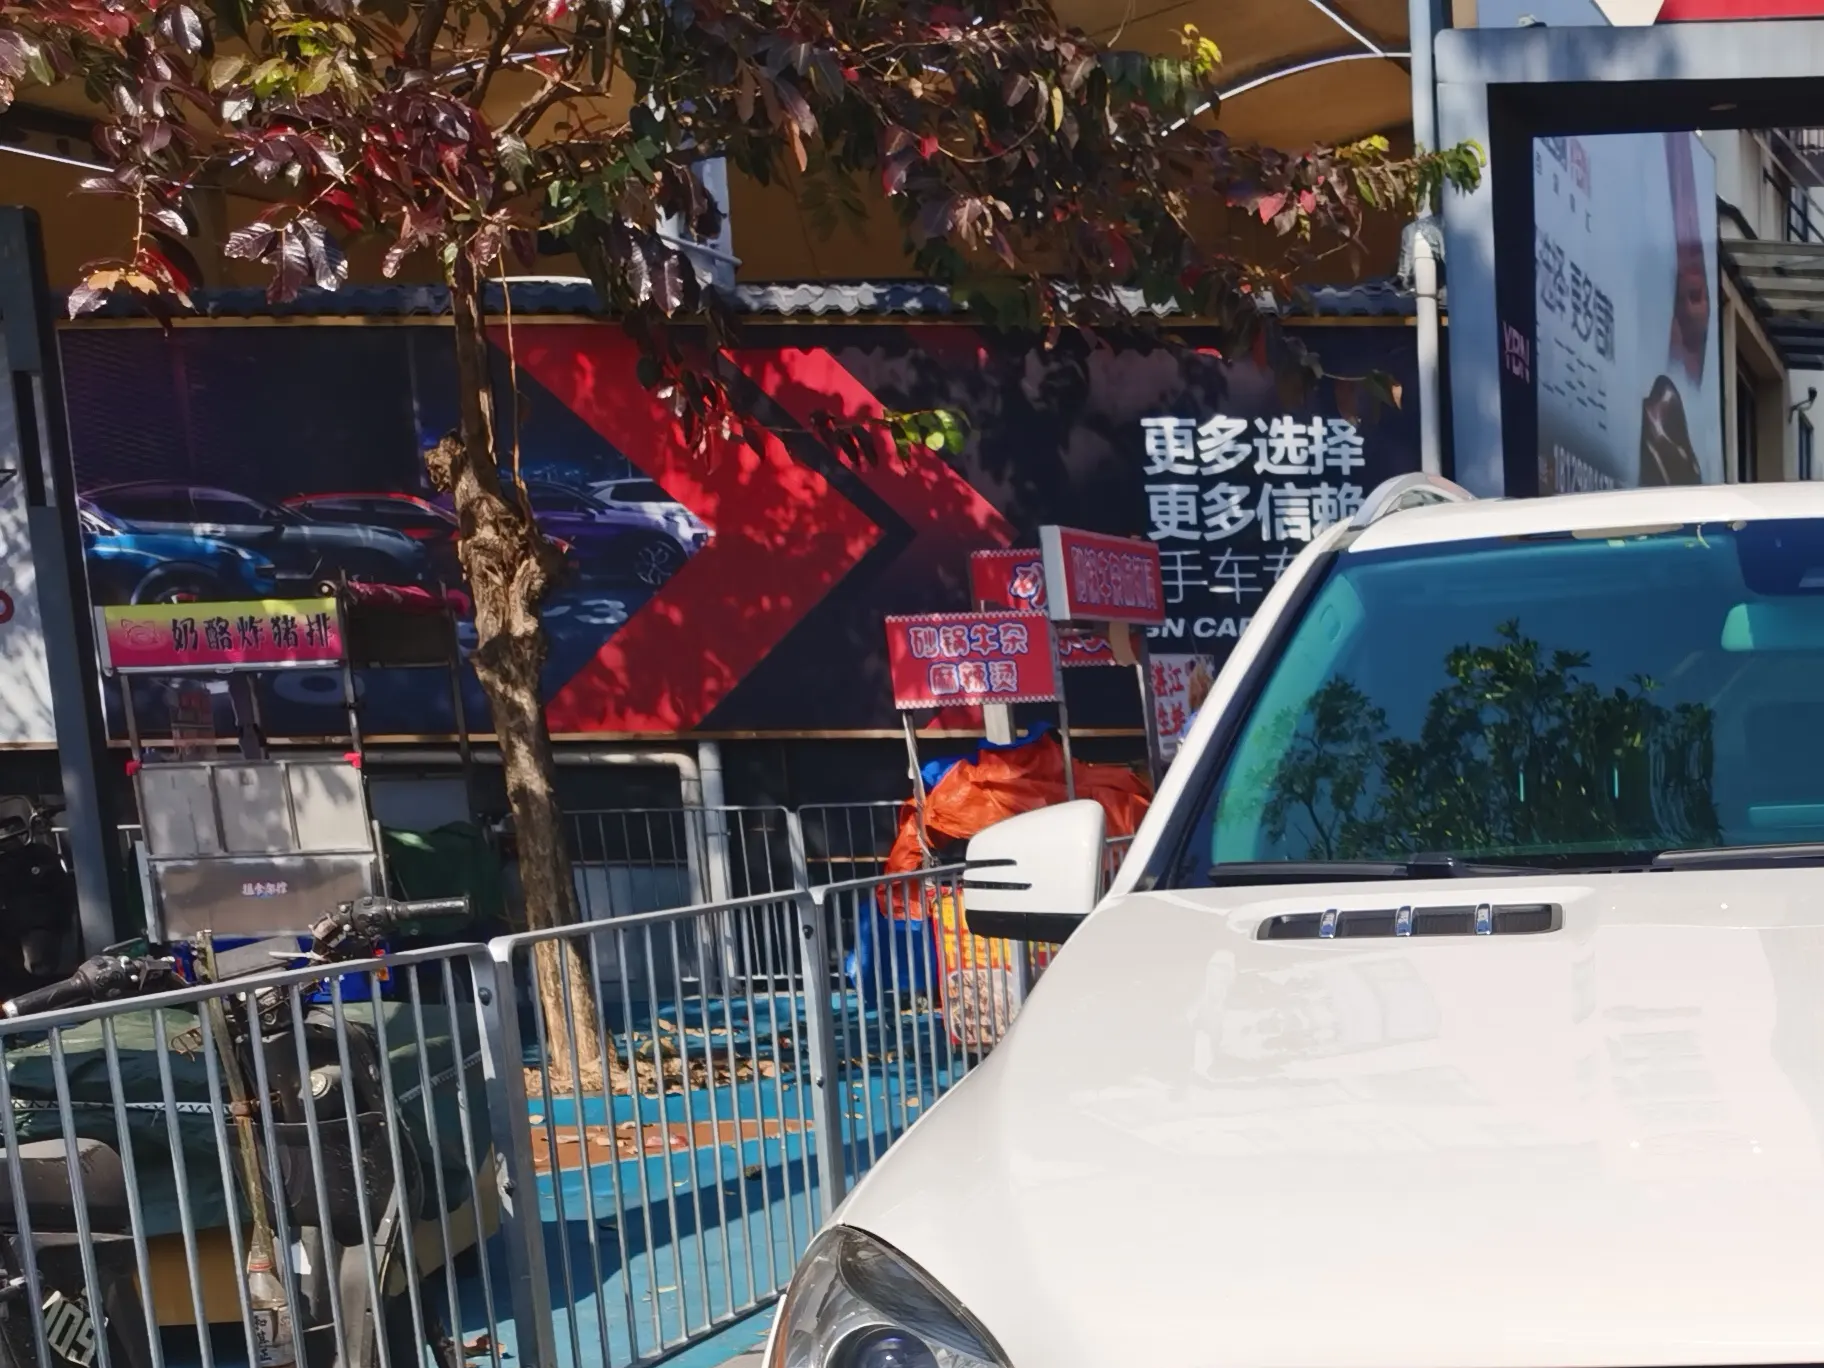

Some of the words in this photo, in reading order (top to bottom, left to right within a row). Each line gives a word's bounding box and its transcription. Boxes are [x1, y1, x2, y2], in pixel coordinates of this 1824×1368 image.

[1140, 414, 1366, 476] 更多选择
[1144, 481, 1366, 542] 更多信赖
[171, 612, 331, 651] 奶酪炸猪排
[908, 622, 1029, 658] 砂锅牛杂
[929, 660, 1019, 696] 麻辣烫
